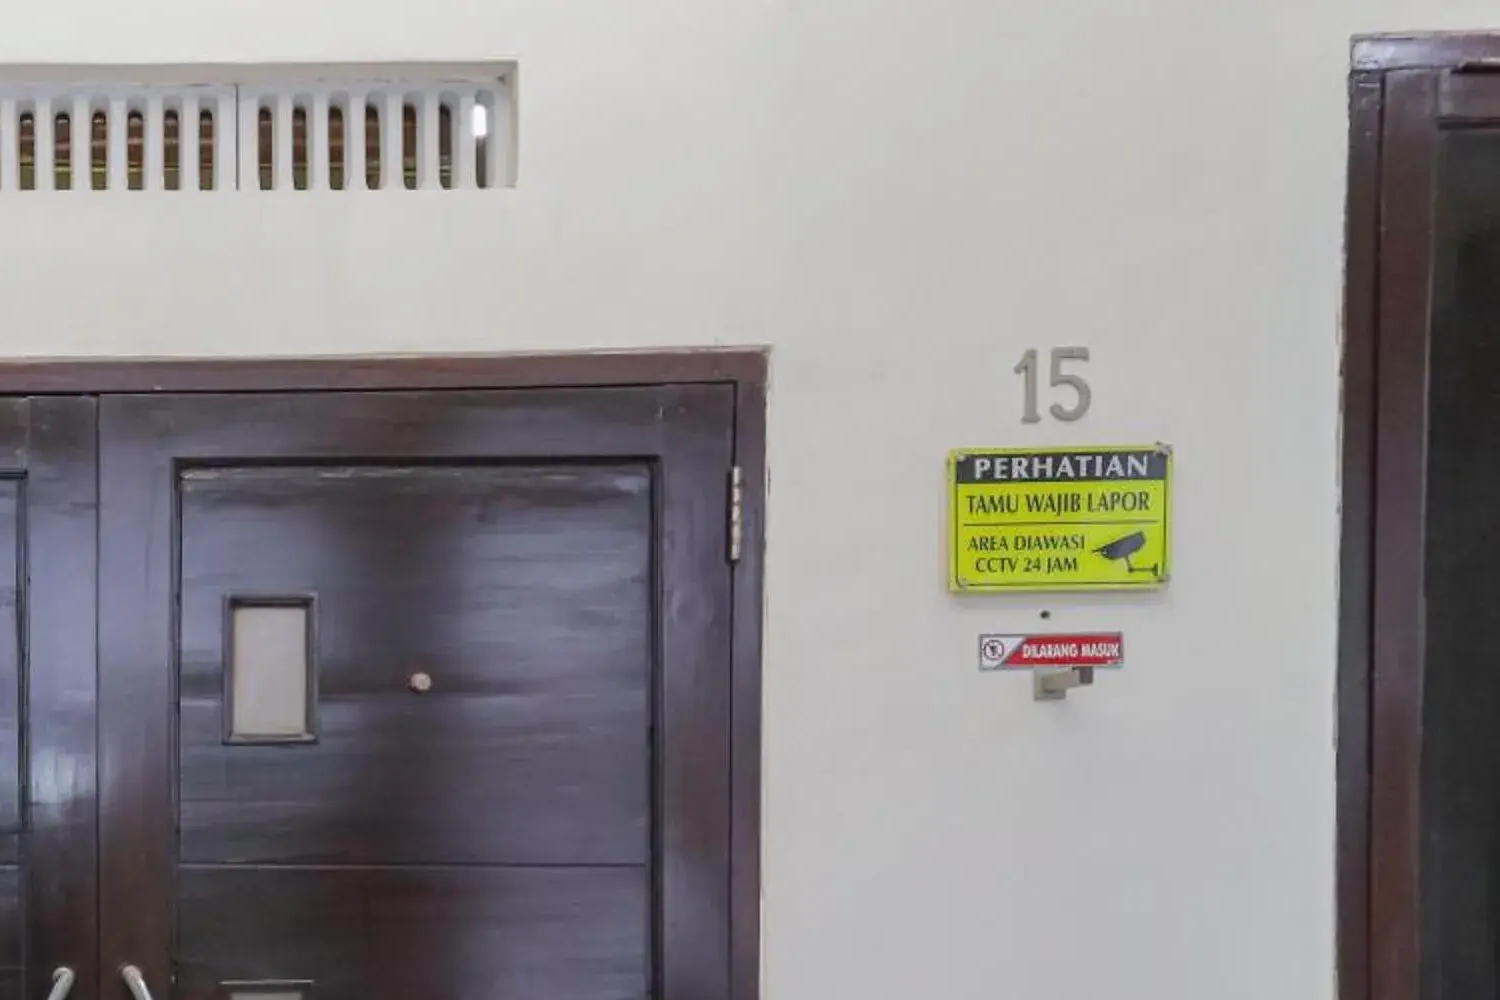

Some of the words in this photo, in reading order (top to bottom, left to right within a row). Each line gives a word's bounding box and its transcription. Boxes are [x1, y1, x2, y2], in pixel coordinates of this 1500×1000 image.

[1013, 347, 1091, 424] 15
[974, 455, 1148, 480] PERHATIAN
[966, 495, 1019, 515] TAMU
[1026, 493, 1081, 516] WAJIB
[1087, 491, 1150, 512] LAPOR
[967, 536, 1009, 551] AREA
[1015, 535, 1085, 551] DIAWASI
[975, 558, 1019, 573] CCTV
[1023, 557, 1041, 572] 24
[1047, 557, 1079, 574] JAM
[1081, 643, 1119, 657] MASUK
